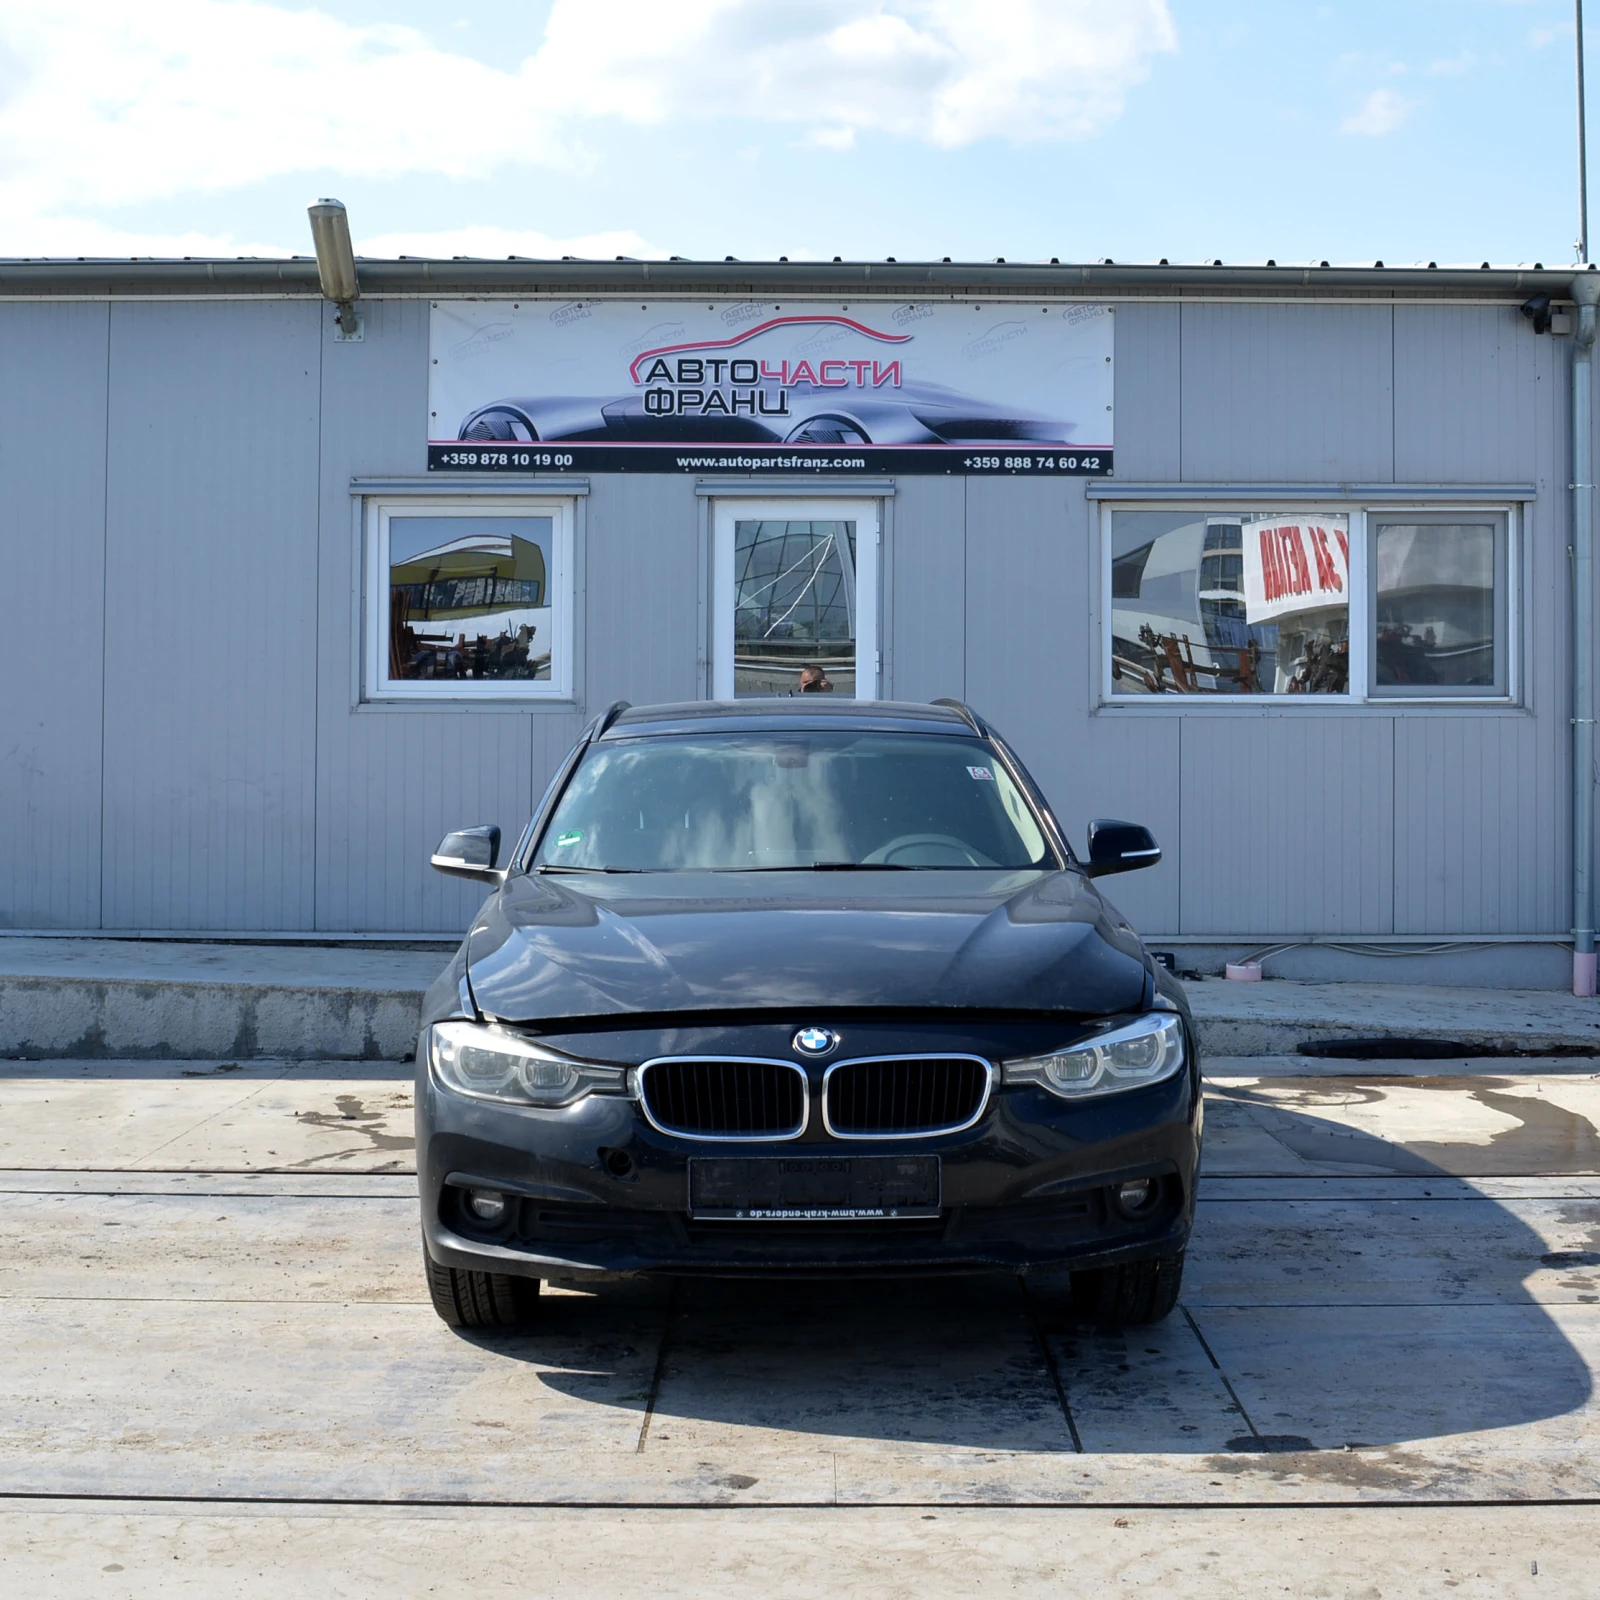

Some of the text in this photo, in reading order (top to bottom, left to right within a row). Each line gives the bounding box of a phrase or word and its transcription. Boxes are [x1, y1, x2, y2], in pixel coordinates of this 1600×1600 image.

[645, 359, 900, 386] АВТОЧАСТИ
[644, 387, 789, 416] ФРАНЦ
[441, 453, 573, 466] +359 878 10 19 00
[676, 455, 865, 470] www.autopartsfranz.com
[963, 457, 1100, 469] +359 888 74 60 42
[750, 1207, 884, 1218] www.bmw-krah-enders.de
